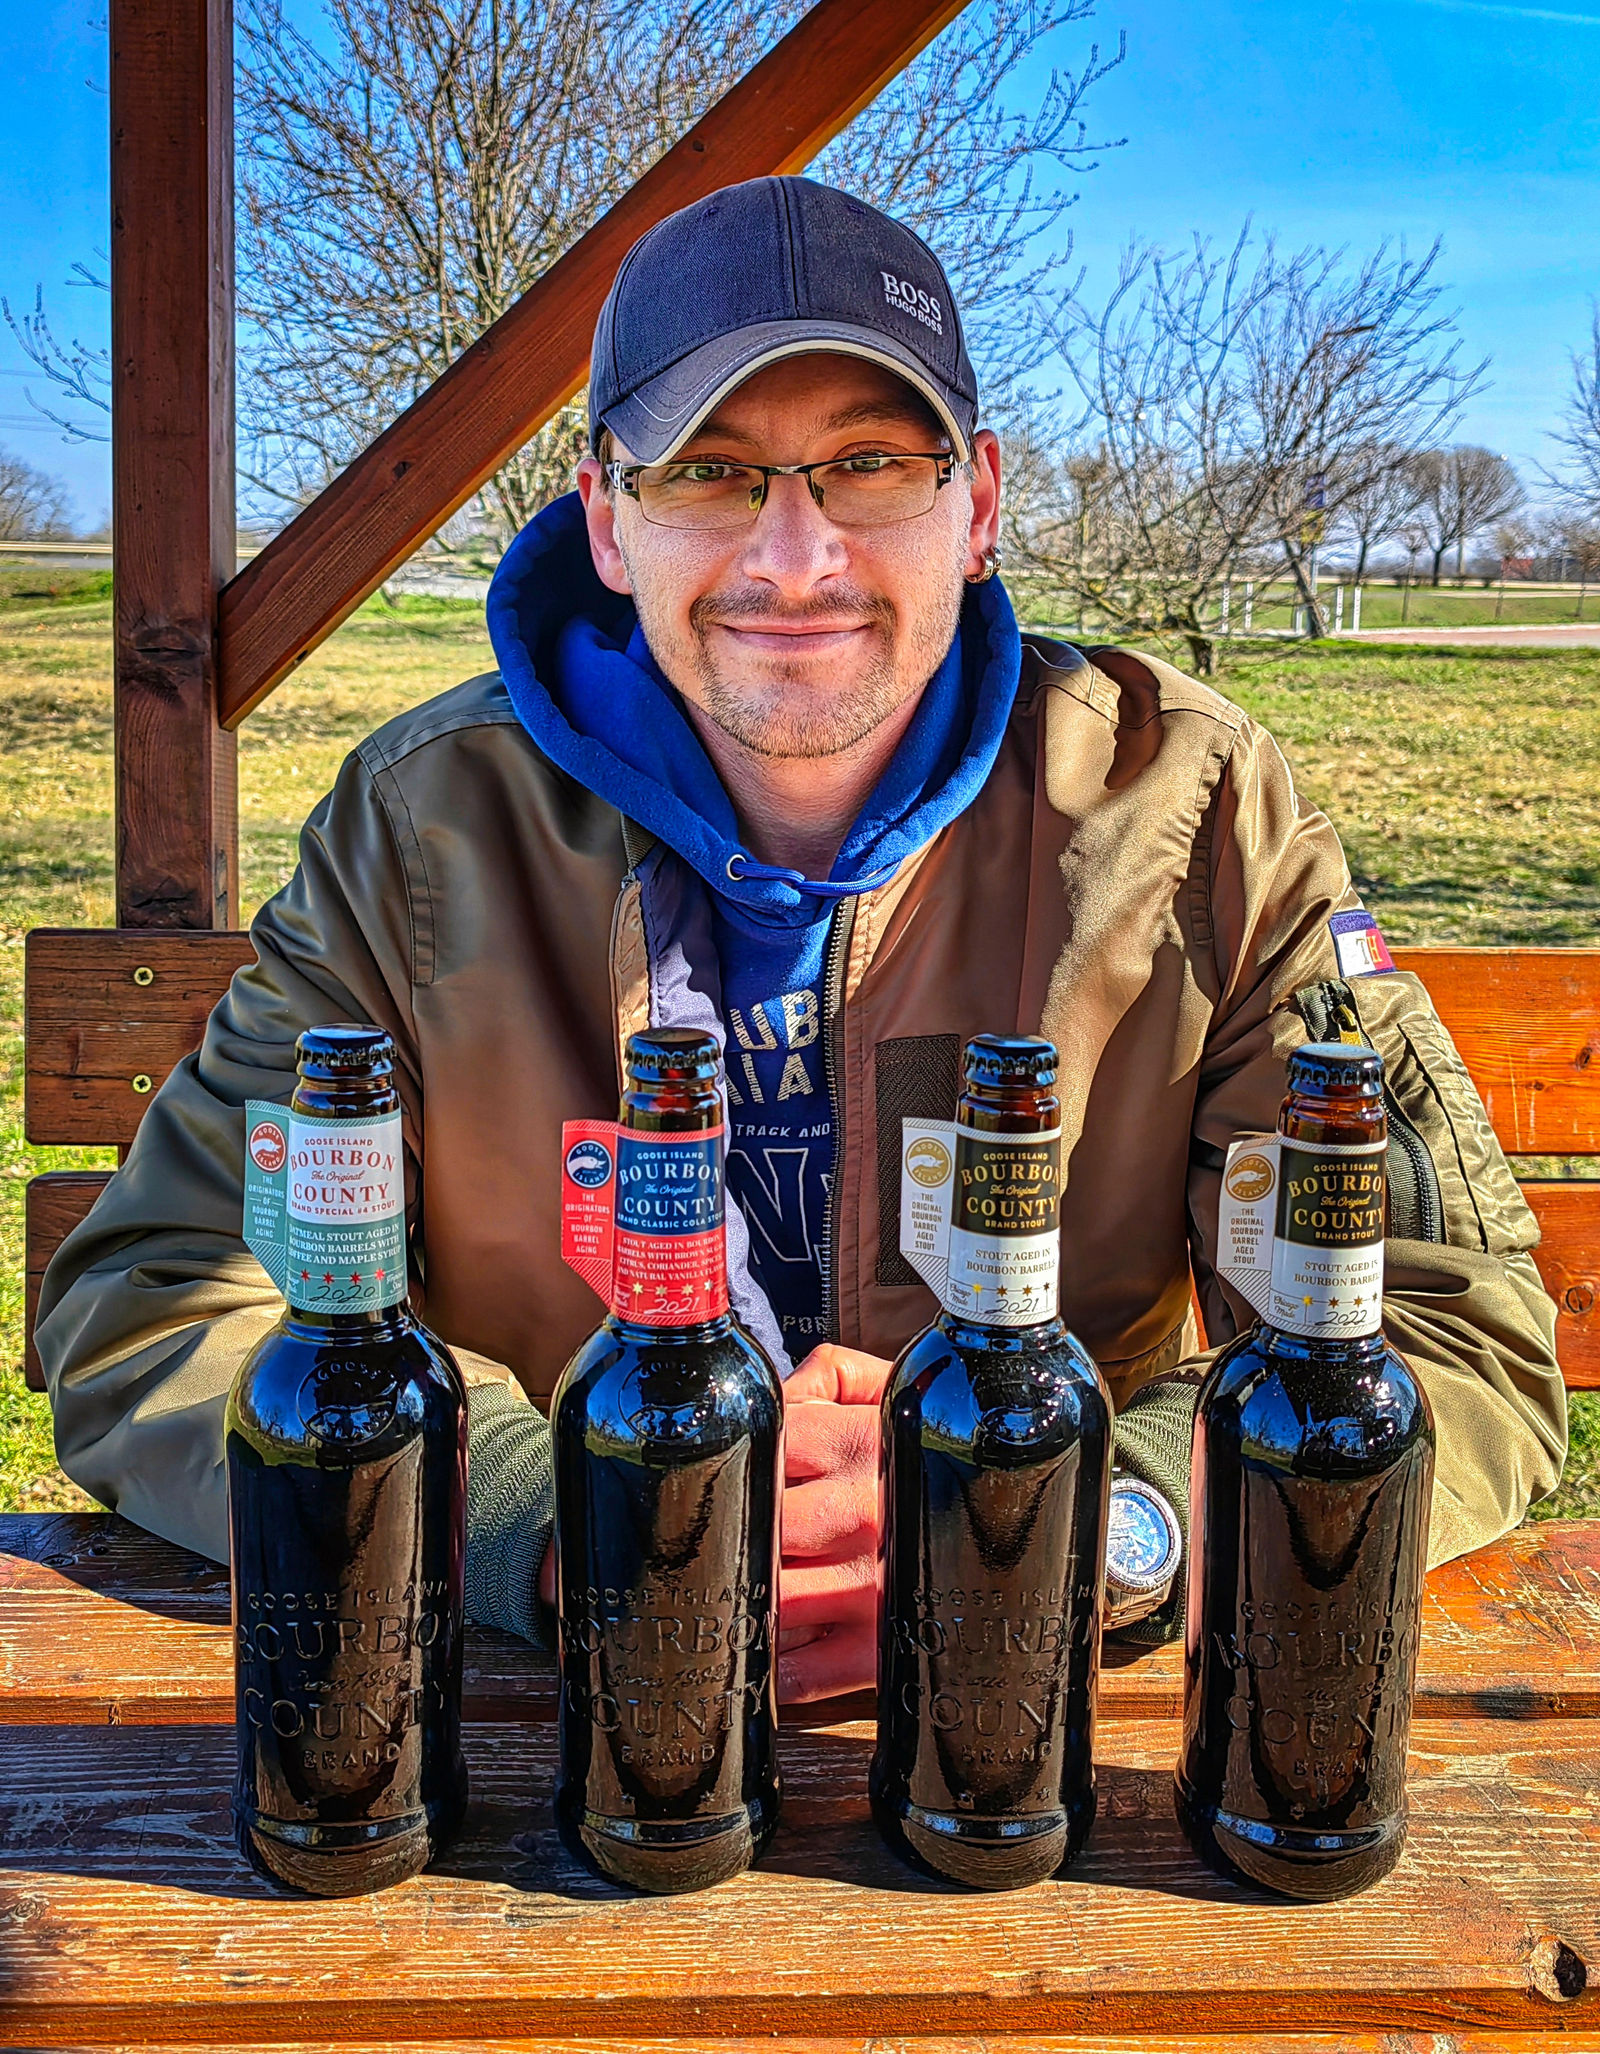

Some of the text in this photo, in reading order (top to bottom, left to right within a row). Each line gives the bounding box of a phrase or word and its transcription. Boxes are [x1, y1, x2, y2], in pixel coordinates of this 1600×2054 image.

[880, 271, 942, 322] BOSS
[885, 293, 943, 336] HUGO BOSS
[258, 1127, 281, 1140] GOOSE
[735, 1122, 831, 1138] TRACK AND
[304, 1138, 374, 1146] GOOSE ISLAND
[576, 1144, 604, 1156] GOOSE
[915, 1143, 942, 1154] GOOSE
[257, 1153, 281, 1167] ISLAND
[290, 1149, 396, 1172] BOURBON
[637, 1151, 704, 1160] GOOSE ISLAND
[983, 1152, 1049, 1161] GOOSE ISLAND
[1237, 1159, 1266, 1170] GOOSE
[1313, 1163, 1379, 1172] GOOSE ISLAND
[262, 1175, 273, 1184] THE
[311, 1170, 365, 1184] The Original
[575, 1172, 605, 1183] ISLAND
[914, 1169, 943, 1181] ISLAND
[248, 1184, 285, 1199] ORIGINATORS
[644, 1182, 696, 1197] The Original
[989, 1183, 1042, 1198] The Original
[1234, 1184, 1265, 1196] ISLAND
[1287, 1174, 1383, 1199] BOURBO
[293, 1182, 389, 1204] COUNTY
[582, 1193, 595, 1202] THE
[921, 1193, 934, 1202] THE
[262, 1197, 270, 1205] OF
[624, 1194, 717, 1217] COUNTY
[911, 1201, 943, 1213] ORIGINAL
[966, 1195, 1057, 1218] COUNTY
[1320, 1194, 1372, 1210] The Original
[252, 1205, 279, 1218] BOURBON
[291, 1200, 312, 1213] BRAND
[315, 1207, 353, 1216] SPECIAL
[372, 1200, 395, 1213] STOUT
[565, 1203, 610, 1214] ORIGINATORS
[1241, 1208, 1255, 1216] THE
[254, 1216, 276, 1228] BARREL
[583, 1214, 593, 1223] OF
[617, 1212, 639, 1225] BRAND
[641, 1219, 679, 1229] CLASSIC
[682, 1217, 706, 1228] COLA
[911, 1211, 942, 1223] BOURBON
[1230, 1217, 1265, 1227] ORIGINAL
[571, 1224, 604, 1234] BOURBON
[913, 1221, 938, 1233] BARREL
[985, 1218, 1046, 1229] BRAND STOUT
[255, 1227, 274, 1239] AGING
[326, 1232, 365, 1242] STOUT
[366, 1226, 391, 1240] AGED
[391, 1222, 400, 1233] IN
[916, 1231, 934, 1241] AGED
[1230, 1227, 1264, 1236] BOURBON
[1315, 1229, 1376, 1240] BRAND STOUT
[328, 1242, 377, 1253] BARRELS
[378, 1234, 399, 1248] WITH
[574, 1234, 600, 1244] BARREL
[623, 1237, 646, 1249] STOUT
[648, 1242, 673, 1250] AGED
[1232, 1237, 1260, 1246] BARREL
[576, 1245, 597, 1255] AGING
[915, 1241, 936, 1251] STOUT
[1235, 1246, 1255, 1255] AGED
[313, 1255, 337, 1265] AND
[338, 1252, 377, 1265] MAPLE
[378, 1244, 402, 1261] SYRUP
[647, 1252, 672, 1260] WITH
[674, 1250, 705, 1260] BROWN
[975, 1247, 1051, 1261] STOUT AGED IN
[1233, 1255, 1256, 1265] STOUT
[647, 1261, 700, 1271] CORIANDER,
[966, 1260, 1018, 1275] BOURBON
[1304, 1261, 1343, 1273] STOUT
[1344, 1262, 1370, 1273] AGED
[629, 1269, 667, 1281] NATURAL
[668, 1270, 704, 1281] VANILLA
[1294, 1271, 1380, 1287] BOURBON BARREL
[308, 1284, 376, 1304] 2020
[643, 1296, 700, 1315] 2021
[984, 1297, 1040, 1315] 2021
[1314, 1309, 1368, 1326] 2022
[248, 1592, 338, 1611] GOOSE
[566, 1669, 770, 1739] COUNTY
[303, 1742, 401, 1770] BRAND
[620, 1744, 715, 1767] BRAND
[961, 1742, 1052, 1764] BRAND
[1294, 1752, 1380, 1778] BRAND
